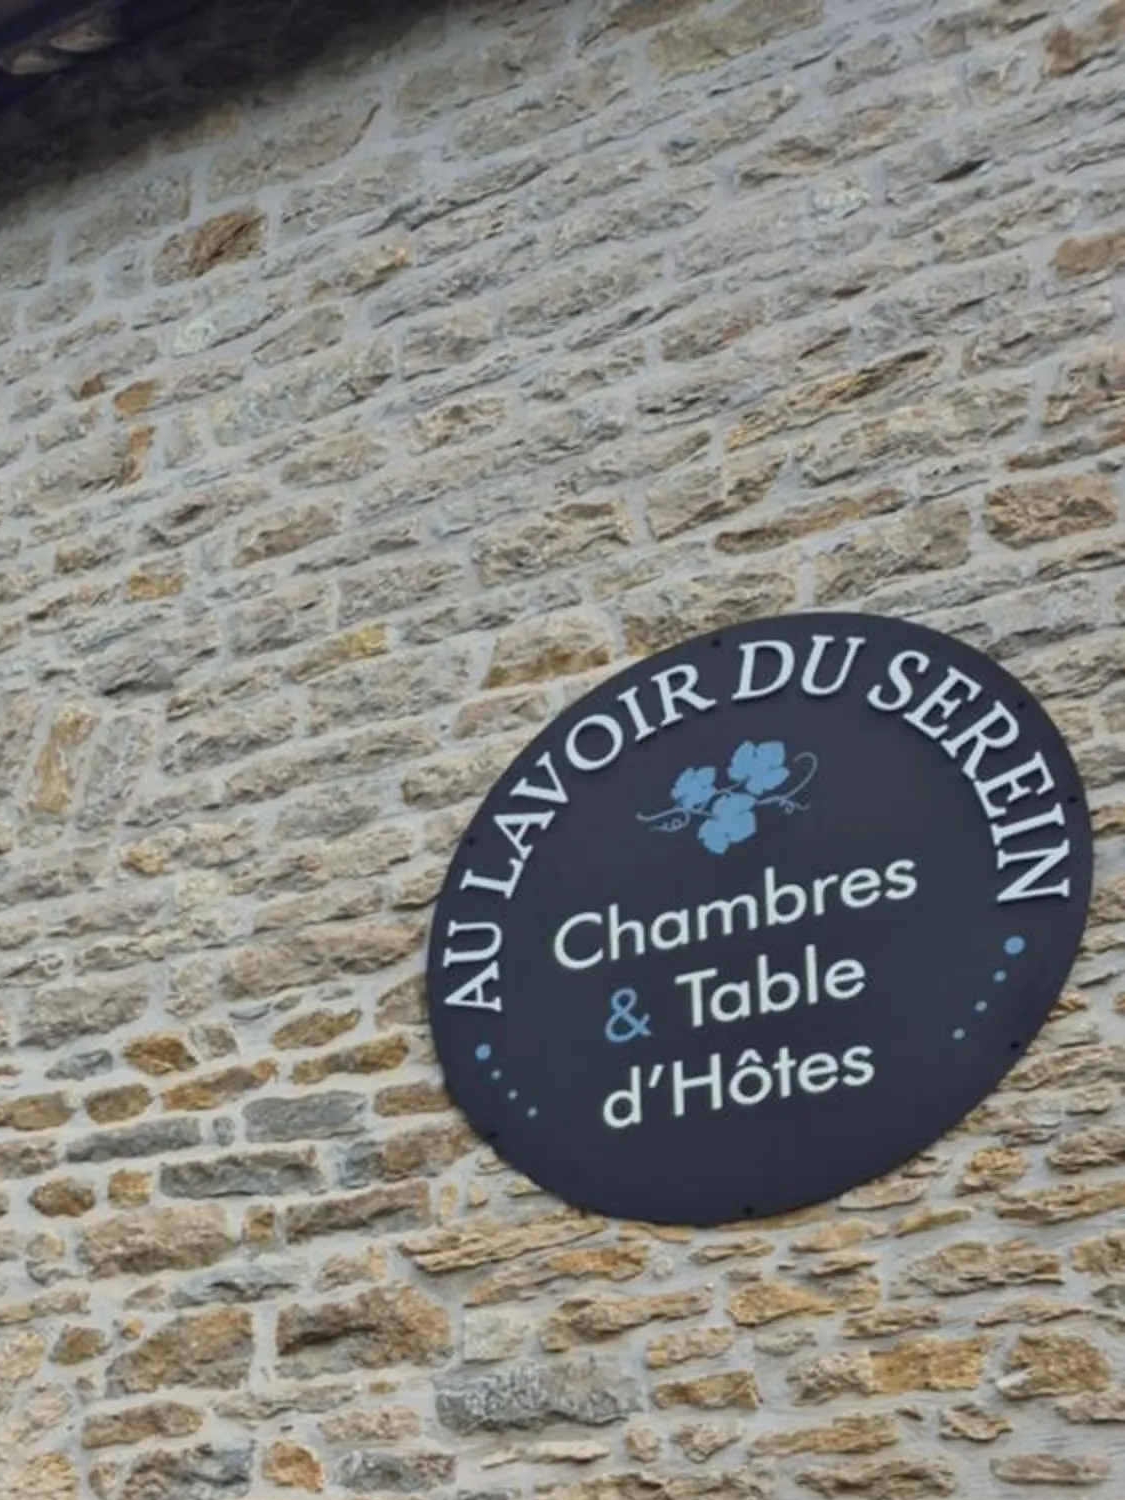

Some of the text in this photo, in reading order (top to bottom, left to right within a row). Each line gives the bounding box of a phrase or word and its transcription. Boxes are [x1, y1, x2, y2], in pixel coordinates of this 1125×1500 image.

[443, 635, 1071, 1012] AU LAVOIR DU SEREIN
[553, 857, 918, 970] Chambres
[604, 943, 866, 1043] & Table
[602, 1044, 875, 1129] d'Hôtes
